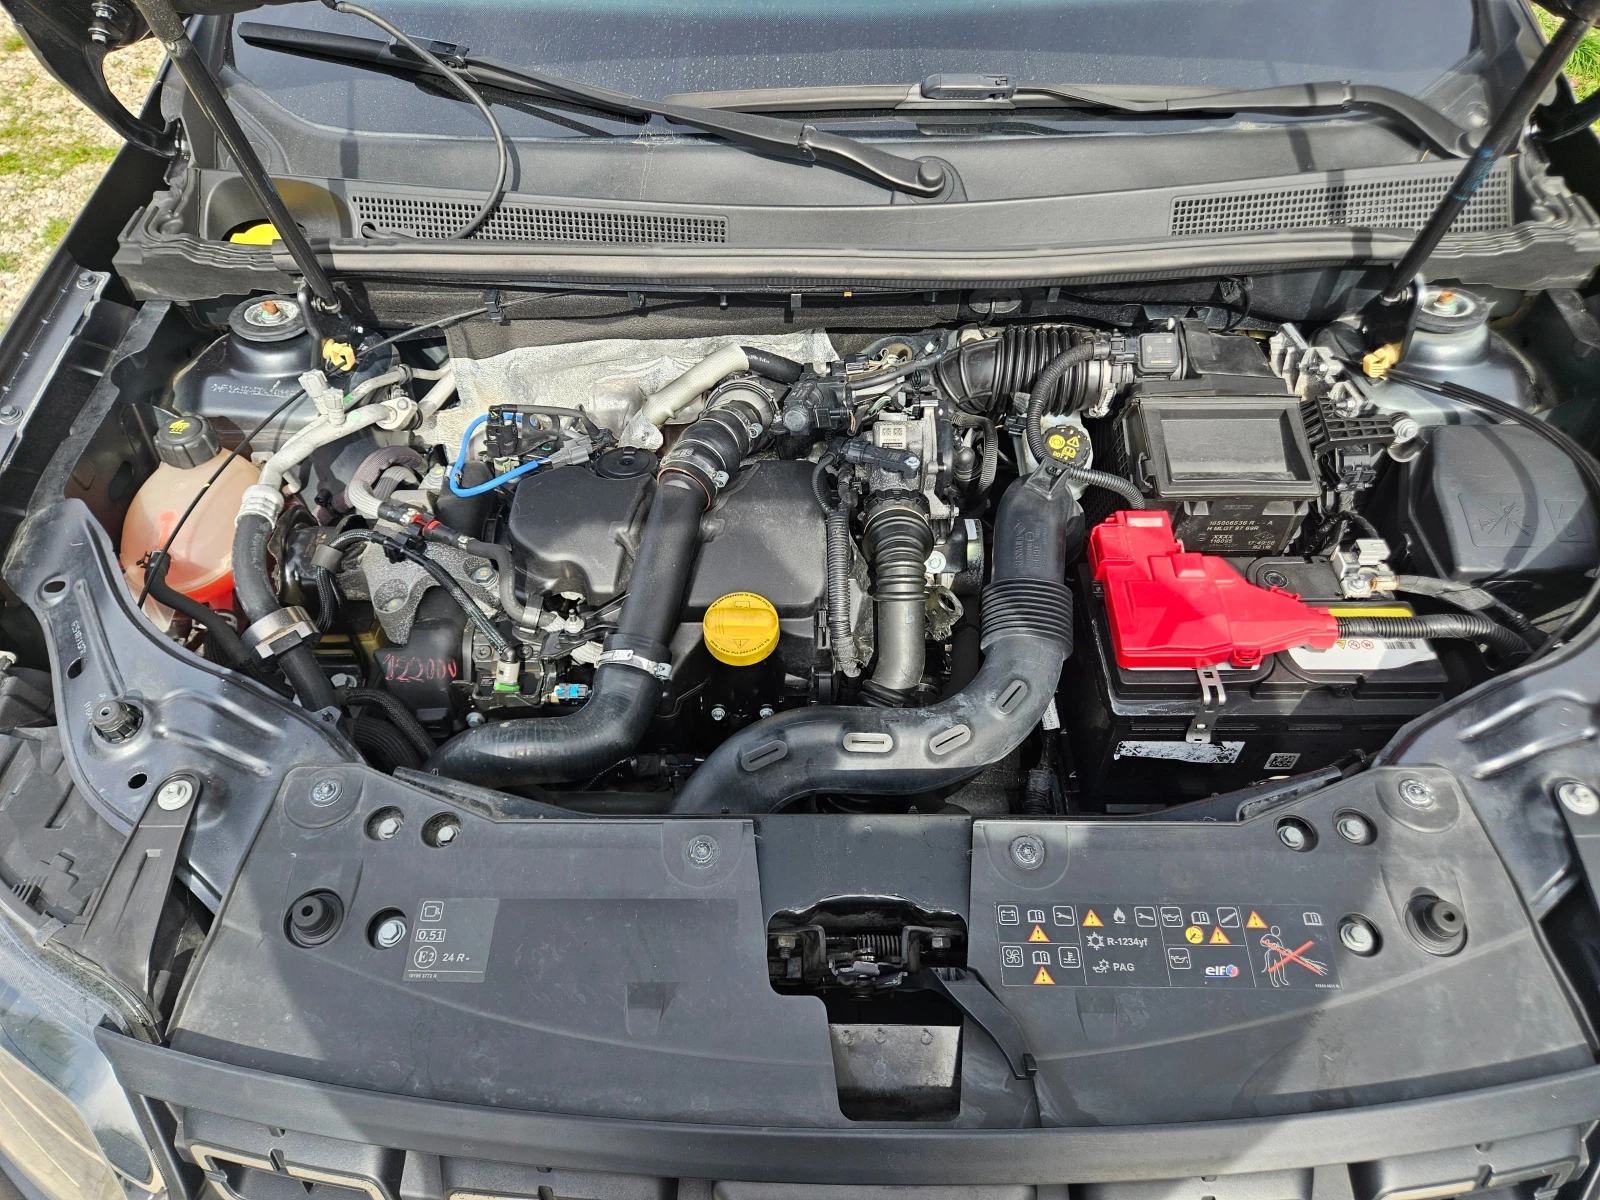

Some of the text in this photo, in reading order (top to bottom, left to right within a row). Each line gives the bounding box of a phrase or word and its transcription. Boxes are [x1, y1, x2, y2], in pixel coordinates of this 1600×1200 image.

[1052, 450, 1064, 459] DOT
[418, 930, 443, 942] 0,51
[1106, 937, 1148, 948] R-1234yf
[417, 950, 435, 963] E2
[442, 953, 455, 962] 24
[1112, 962, 1135, 972] PAG
[1205, 965, 1226, 976] elf
